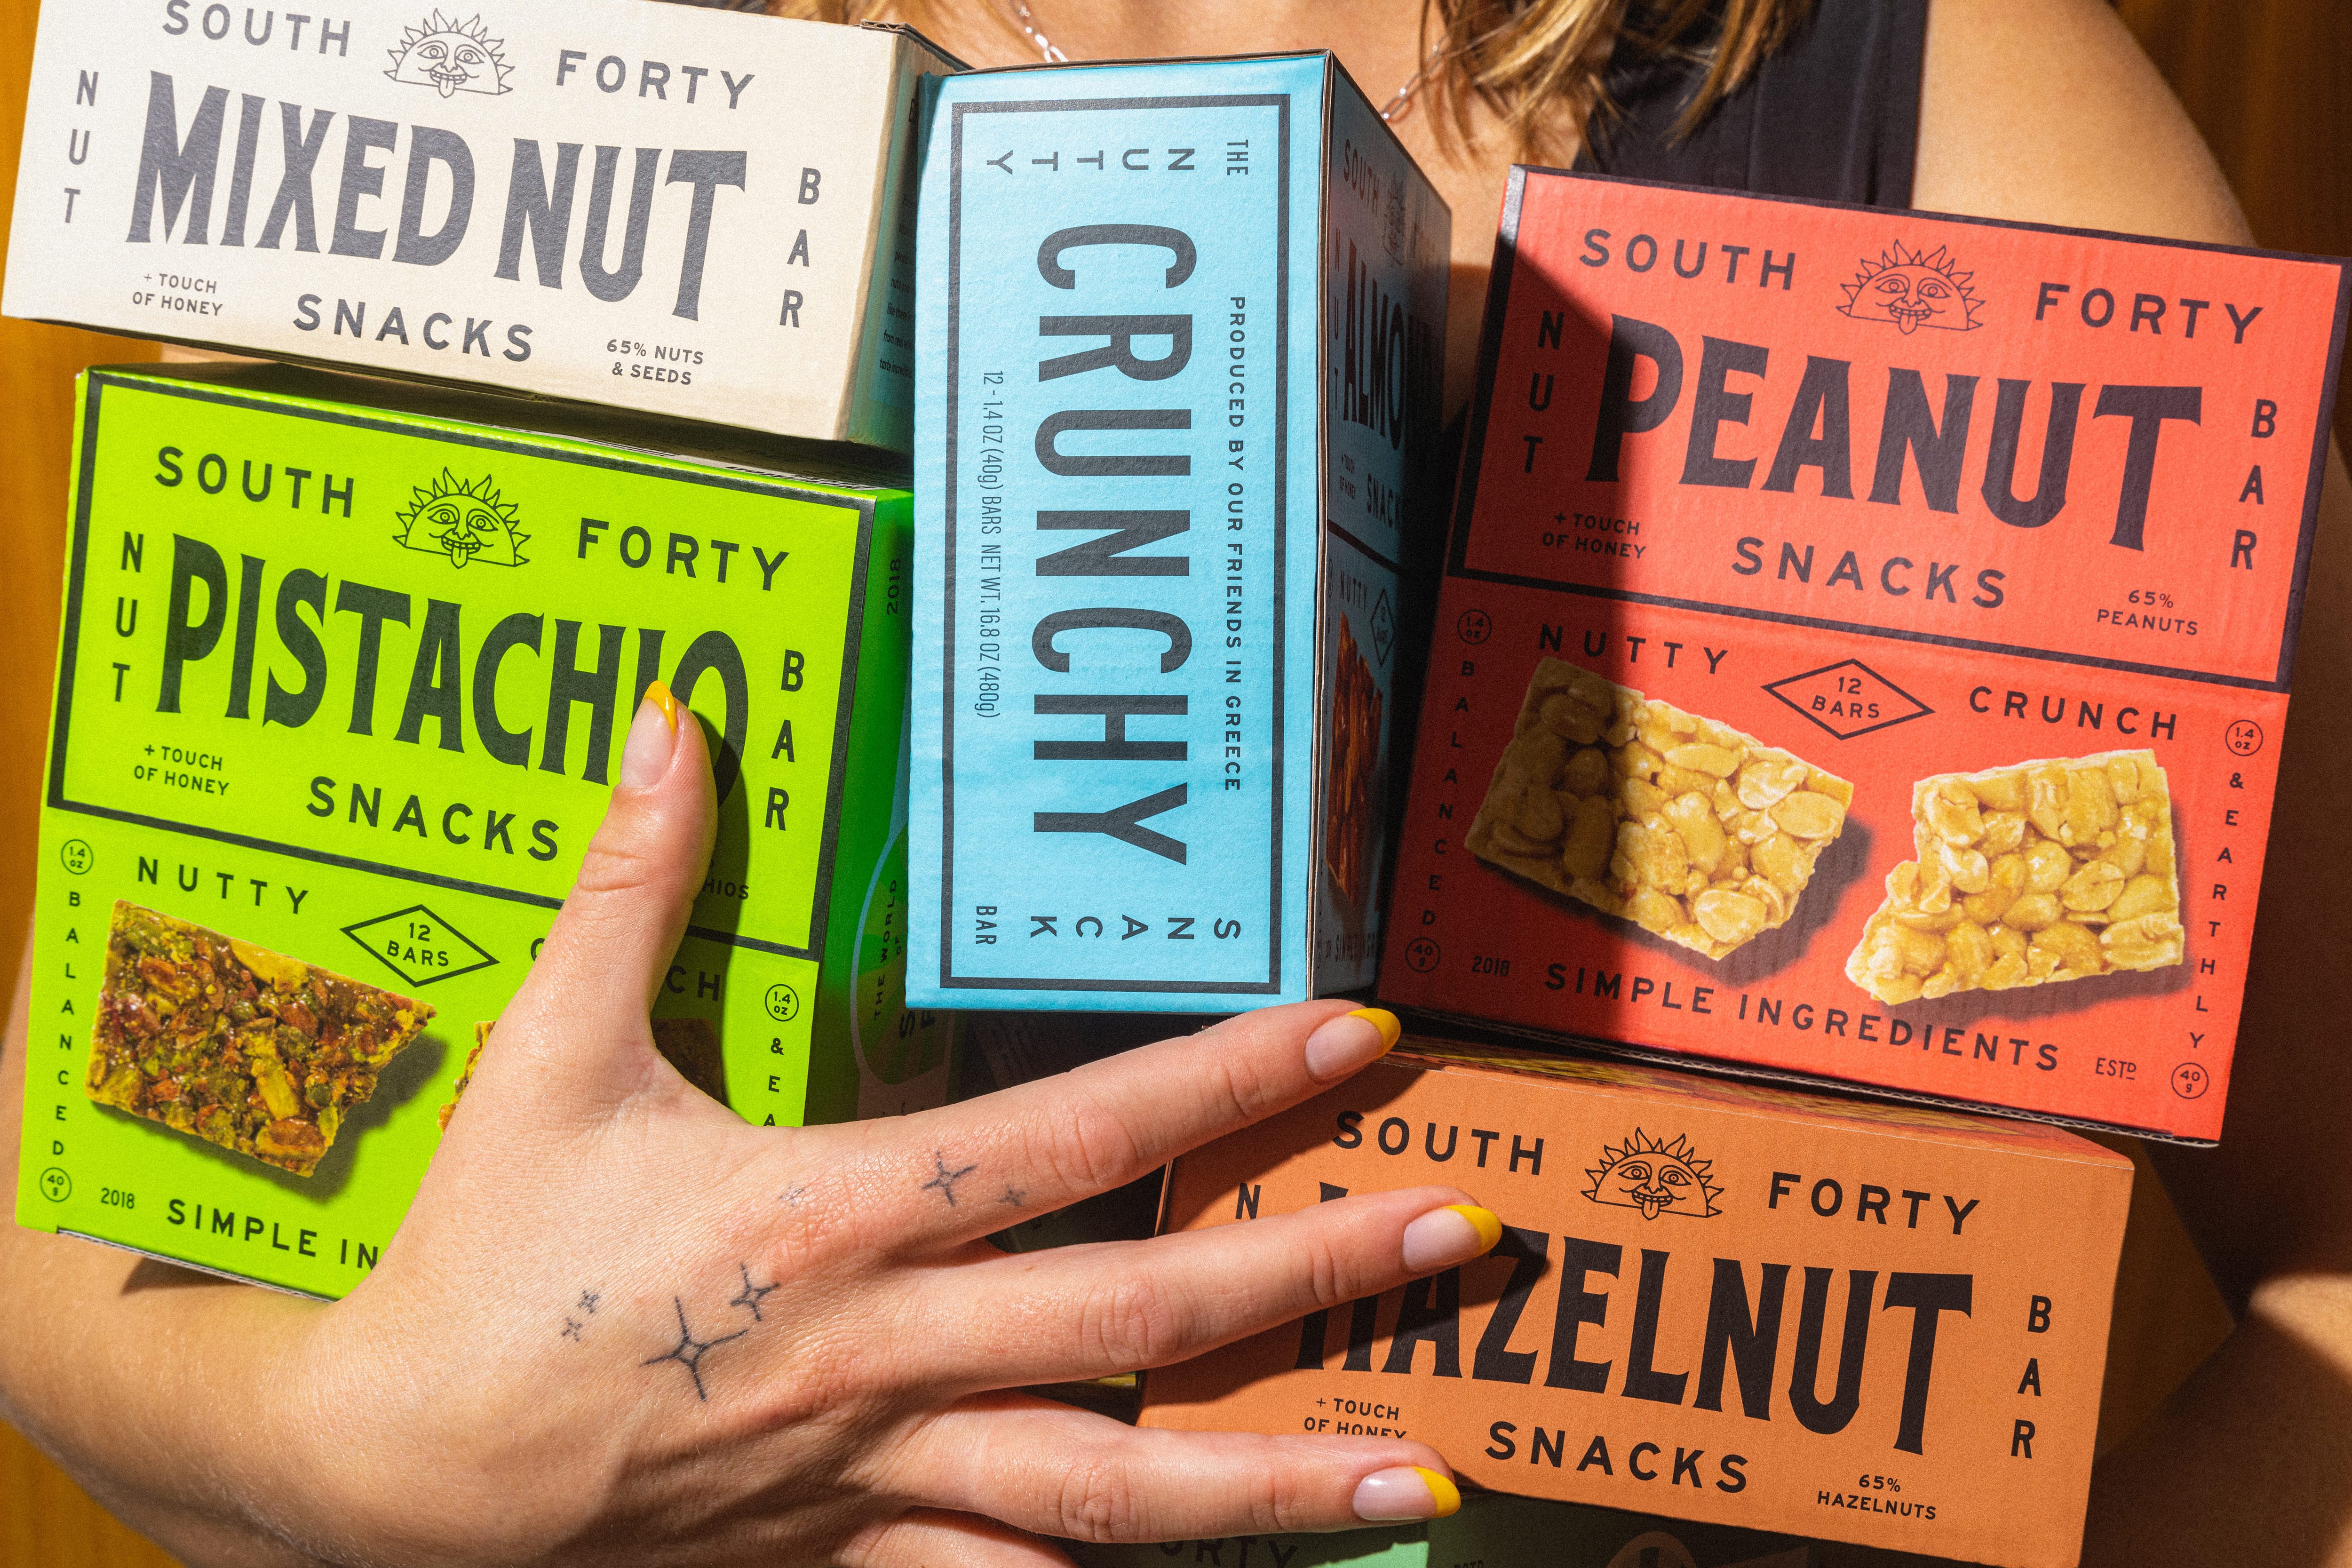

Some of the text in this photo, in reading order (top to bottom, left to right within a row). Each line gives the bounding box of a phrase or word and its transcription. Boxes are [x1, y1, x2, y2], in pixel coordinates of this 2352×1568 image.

[163, 0, 755, 109] SOUTH FORTY
[64, 70, 98, 223] NUT
[987, 149, 1195, 174] NUTTY
[1227, 140, 1248, 175] THE
[1343, 138, 1379, 217] SOUTH
[126, 71, 747, 321] MIXED NUT
[780, 167, 821, 327] BAR
[159, 273, 216, 294] TOUCH
[1580, 229, 2263, 344] SOUTH FORTY
[133, 292, 222, 316] OF HONEY
[293, 294, 532, 362] SNACKS
[1343, 237, 1406, 450] ALMO
[607, 339, 703, 365] 65% NUTS
[612, 362, 691, 385] & SEEDS
[984, 371, 1003, 384] 12
[1524, 310, 1564, 473] NUT
[983, 401, 1003, 420] 1.4
[983, 425, 1003, 443] OZ
[1585, 313, 2202, 551] PEANUT
[977, 448, 1004, 490] (40g)
[2231, 399, 2277, 569] BAR
[155, 446, 789, 591] SOUTH FORTY
[981, 496, 1001, 534] BARS
[1573, 513, 1639, 535] TOUCH
[981, 545, 1001, 572] NET
[1032, 224, 1196, 865] CRUNCHY
[1225, 297, 1245, 790] PRODUCED BY OUR FRIENDS IN GREECE
[1542, 532, 1645, 558] OF HONEY
[887, 559, 902, 615] 2018
[1732, 537, 2005, 608] SNACKS
[981, 577, 1000, 603] WT.
[2129, 590, 2173, 608] 65%
[113, 532, 143, 702] NUT
[980, 608, 1000, 637] 16.8
[2097, 609, 2197, 635] PEANUTS
[980, 643, 1000, 661] OZ
[1539, 623, 1727, 674] NUTTY
[974, 667, 1001, 717] (480g)
[1839, 677, 1861, 695] 12
[1812, 695, 1879, 718] BARS
[1970, 686, 2176, 740] CRUNCH
[765, 650, 804, 831] BAR
[2236, 727, 2254, 738] 1.4
[161, 746, 222, 771] TOUCH
[134, 765, 229, 796] OF HONEY
[307, 776, 559, 861] SNACKS
[67, 846, 85, 859] 1.4
[138, 857, 308, 914] NUTTY
[409, 923, 430, 940] 12
[881, 880, 897, 962] WORLD
[976, 906, 997, 944] BAR
[1031, 915, 1241, 940] SNACK
[387, 940, 448, 966] BARS
[1471, 955, 1510, 977] 2018
[773, 991, 790, 1004] 1.4
[1544, 963, 2058, 1071] SIMPLE INGREDIENTS
[2180, 1070, 2200, 1082] 40
[47, 1175, 64, 1186] 40
[1332, 1110, 1979, 1235] SOUTH FORTY
[101, 1187, 135, 1209] 2018
[167, 1199, 317, 1257] SIMPLE
[2011, 1295, 2051, 1458] BAR
[1304, 1417, 1329, 1432] OF
[1334, 1398, 1399, 1420] TOUCH
[1486, 1421, 1748, 1493] SNACKS
[1859, 1474, 1900, 1492] 65%
[1818, 1491, 1936, 1520] HAZELNUTS
[1160, 1536, 1297, 1568] RTY
